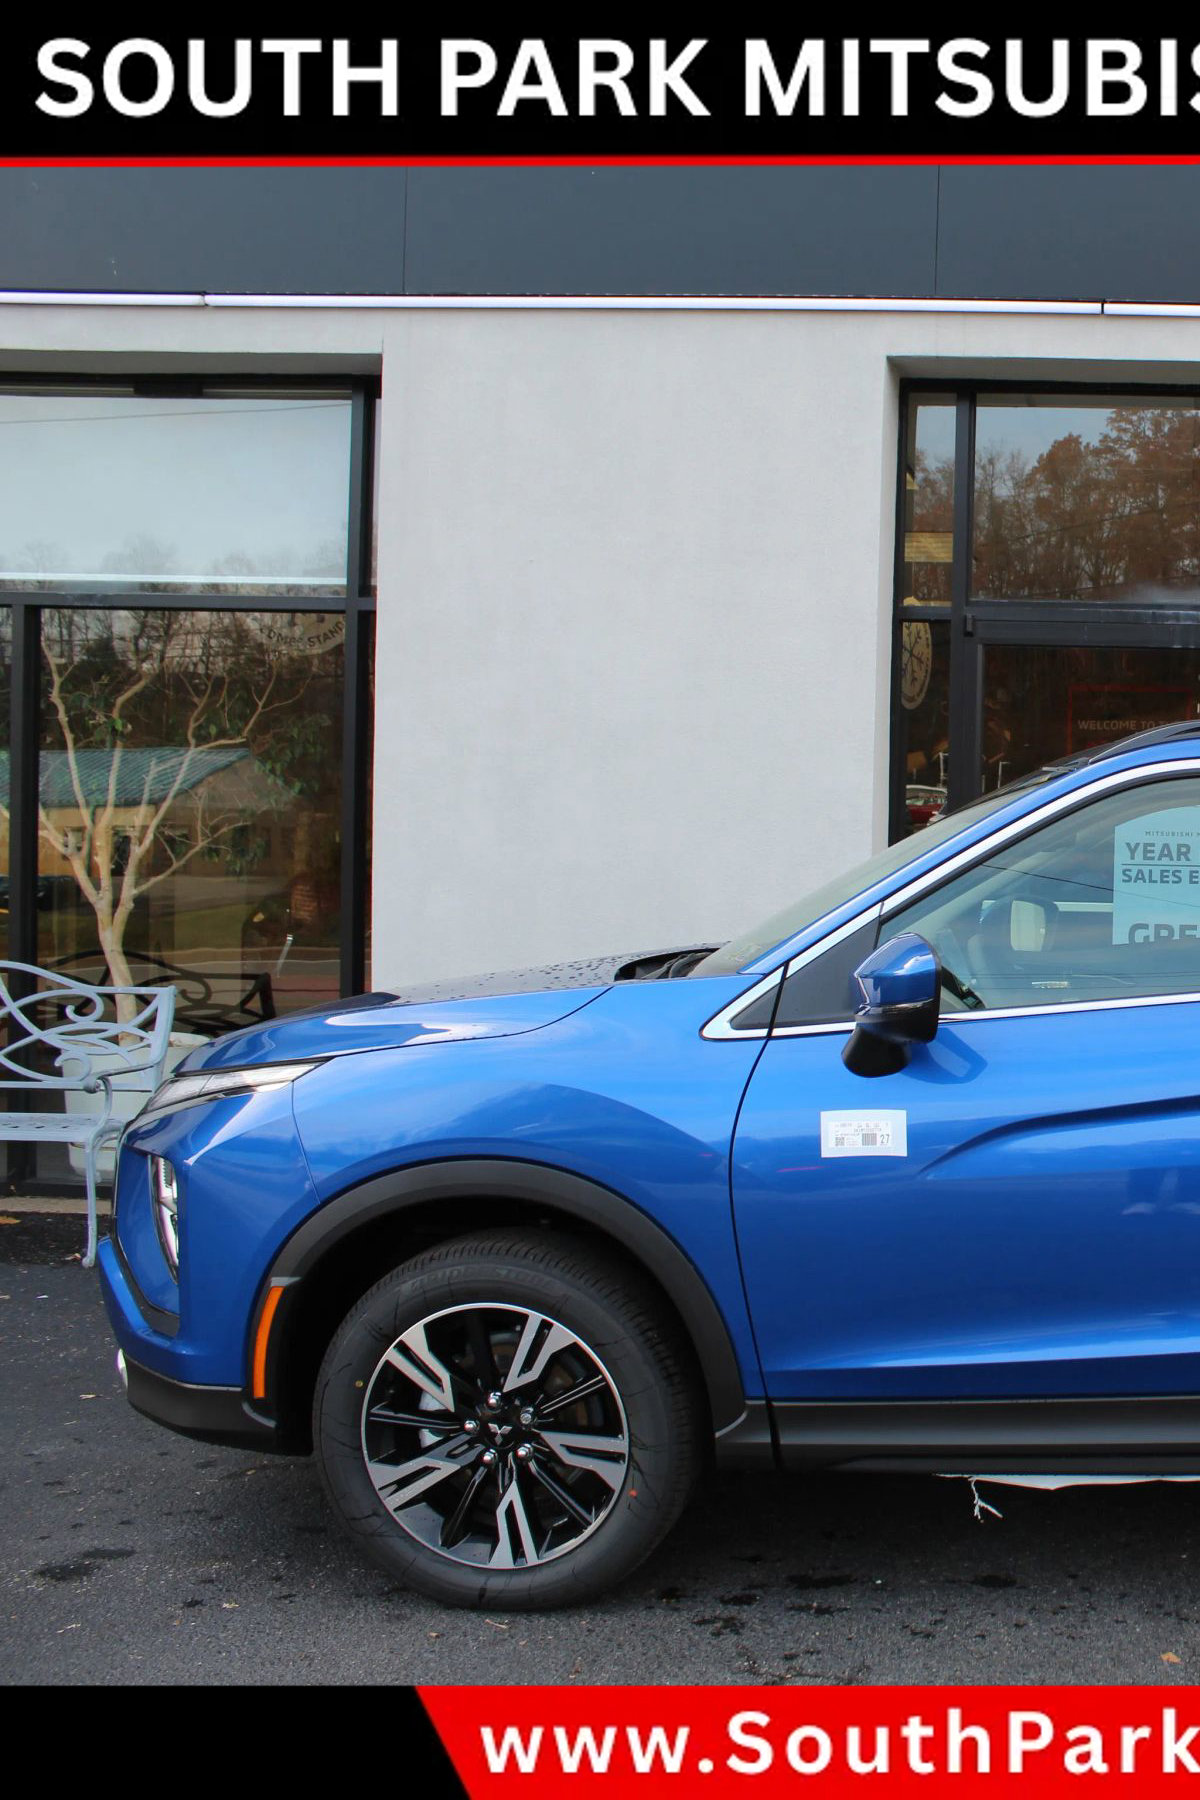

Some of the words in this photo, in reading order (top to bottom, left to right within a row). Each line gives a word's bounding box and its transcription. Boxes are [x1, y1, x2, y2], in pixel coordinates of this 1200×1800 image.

[1077, 720, 1137, 730] WELCOME
[1125, 842, 1191, 861] YEAR
[1121, 868, 1182, 884] SALES
